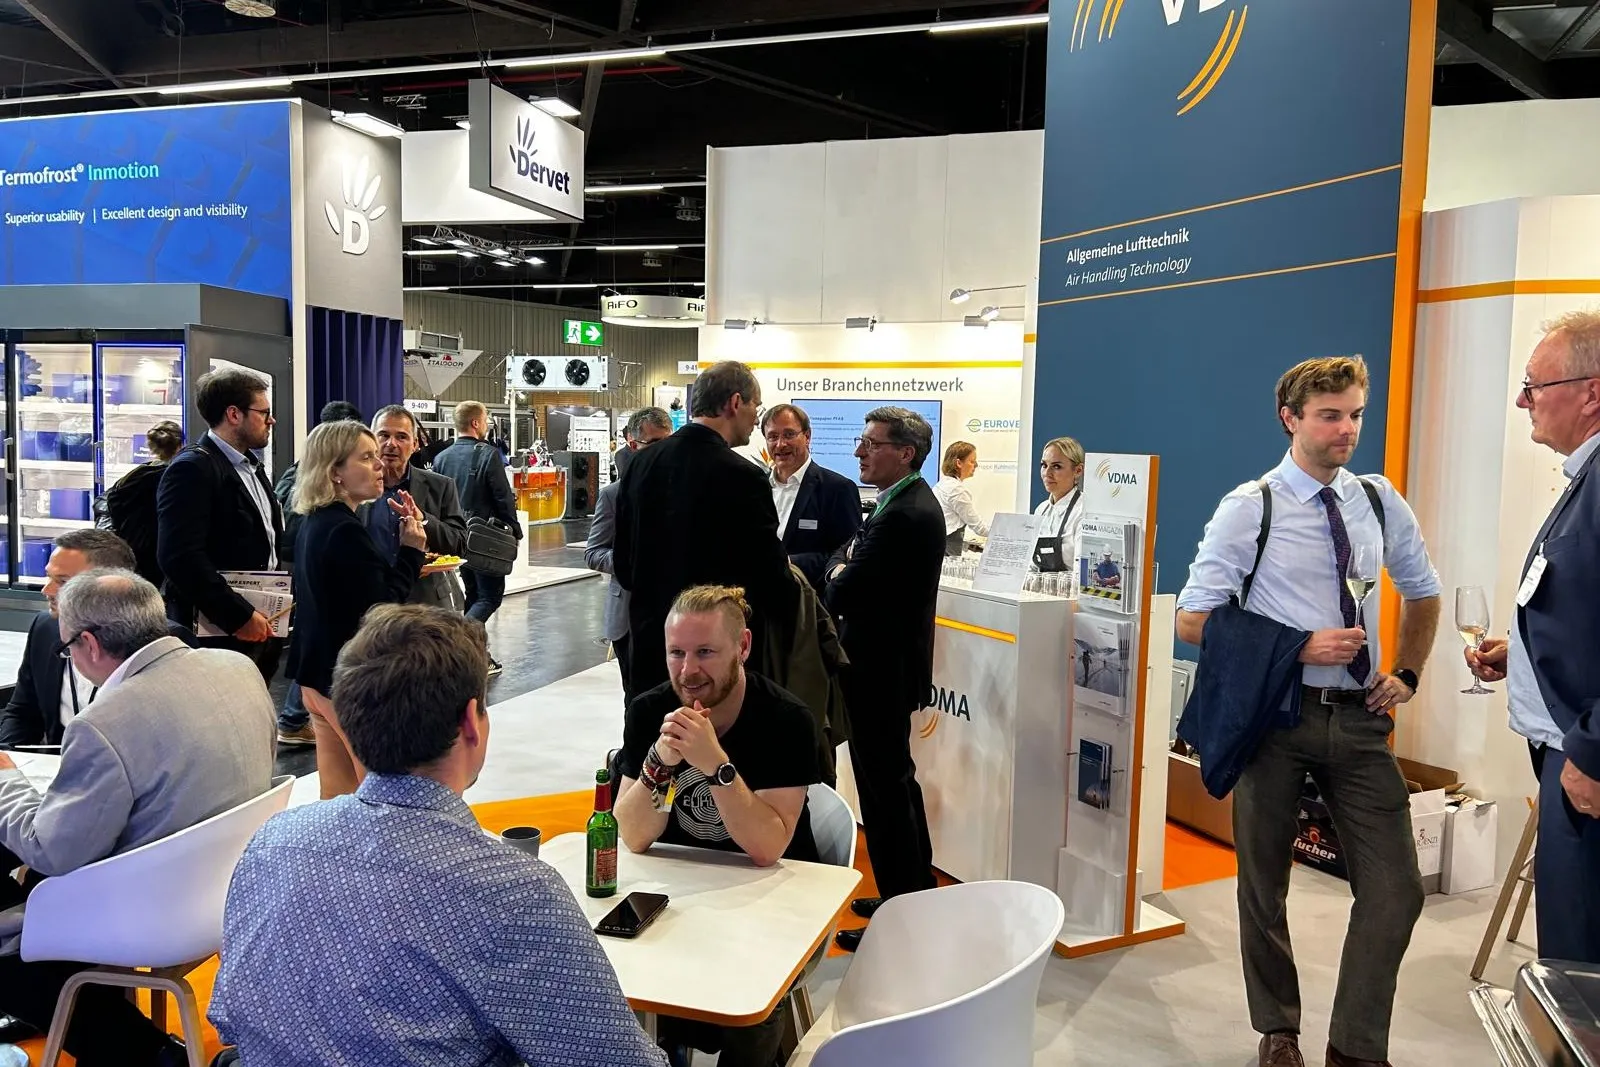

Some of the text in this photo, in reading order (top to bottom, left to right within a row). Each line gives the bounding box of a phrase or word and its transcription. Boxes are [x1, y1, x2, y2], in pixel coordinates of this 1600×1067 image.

[88, 161, 159, 181] Inmotion
[517, 149, 570, 195] Dervet
[5, 202, 248, 226] Superior usability Excellent design and visibility
[1066, 227, 1190, 264] Allgemeine Lufttechnik
[1065, 257, 1192, 287] Air Handling Technology
[777, 377, 964, 391] Unser Branchennetzwerk
[1107, 472, 1137, 485] VDMA
[1082, 523, 1098, 532] VDMA
[919, 684, 971, 722] DMA
[1293, 837, 1336, 860] Tucher
